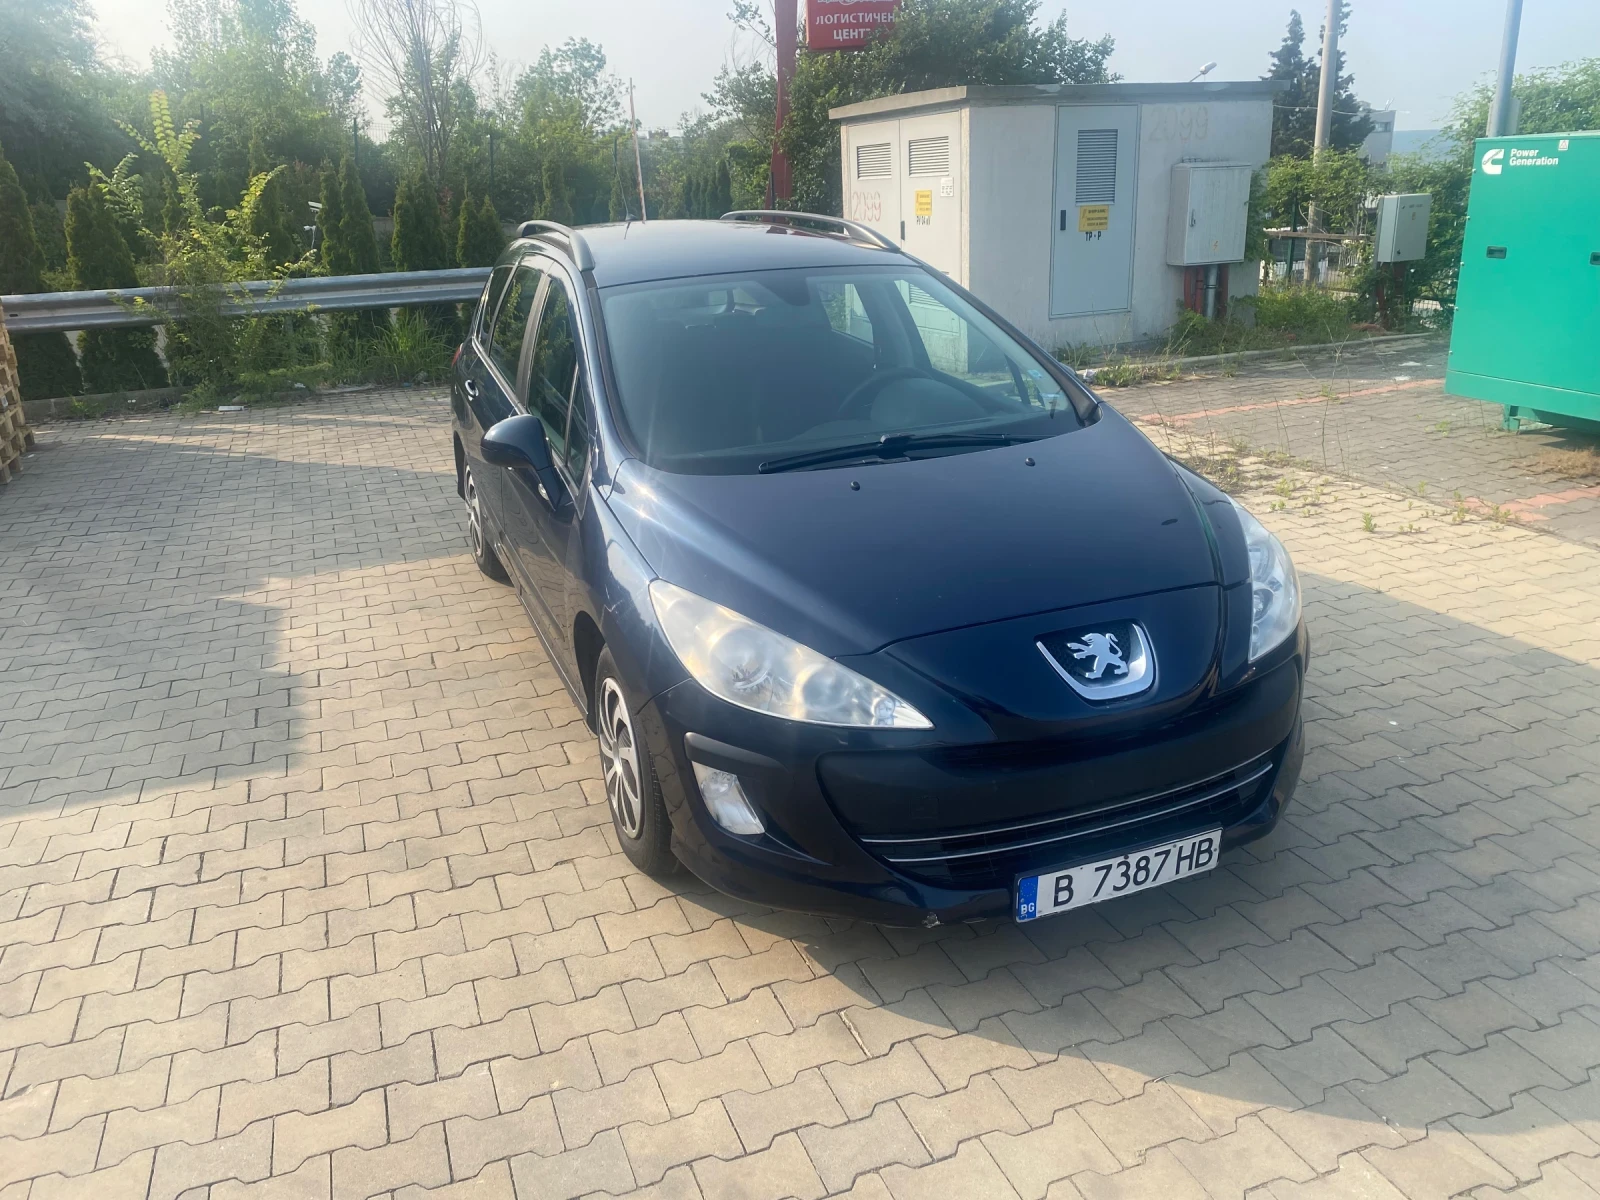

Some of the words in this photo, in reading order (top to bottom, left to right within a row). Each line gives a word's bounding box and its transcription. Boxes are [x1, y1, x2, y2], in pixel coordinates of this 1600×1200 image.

[816, 12, 895, 25] ЛОГИСТИЧЕН
[1510, 148, 1539, 157] Power
[1509, 157, 1559, 166] Generation
[1053, 874, 1074, 908] B
[1020, 902, 1035, 915] BG
